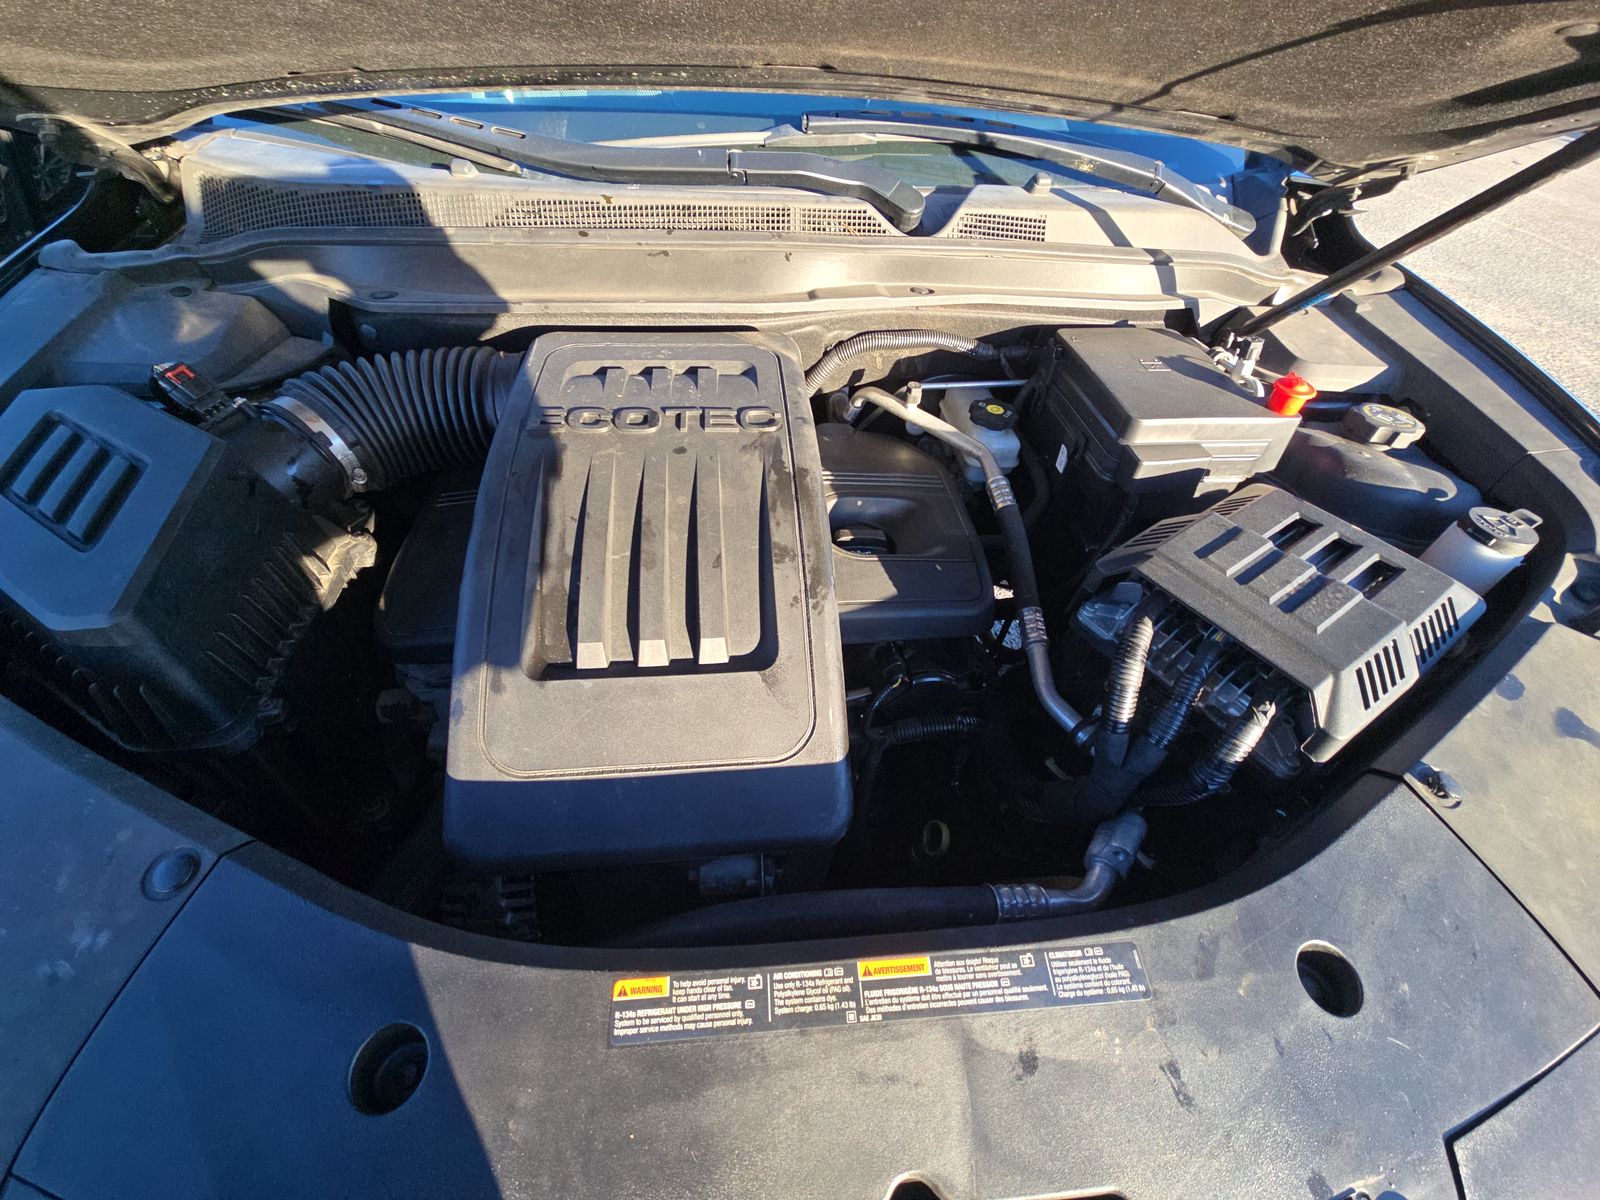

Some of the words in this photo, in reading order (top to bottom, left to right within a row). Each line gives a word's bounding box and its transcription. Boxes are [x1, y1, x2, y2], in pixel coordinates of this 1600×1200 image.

[527, 406, 781, 433] ECOTEC
[874, 964, 924, 975] AVERTISSEMENT
[680, 980, 691, 988] help
[708, 977, 729, 987] personal
[730, 976, 746, 984] injury.
[796, 980, 815, 988] R-134a
[816, 978, 843, 987] Refrigerant
[631, 985, 662, 994] WARNING
[785, 998, 803, 1006] system
[615, 1011, 636, 1019] R-134a
[637, 1006, 676, 1017] REFRIGERANT
[677, 1005, 696, 1013] UNDER
[698, 1004, 711, 1012] HIGH
[713, 1001, 742, 1011] PRESSURE
[775, 1006, 793, 1015] System
[827, 1003, 834, 1011] kg
[614, 1020, 635, 1028] System
[651, 1016, 673, 1024] serviced
[614, 1028, 638, 1037] Improper
[714, 1019, 736, 1028] personal
